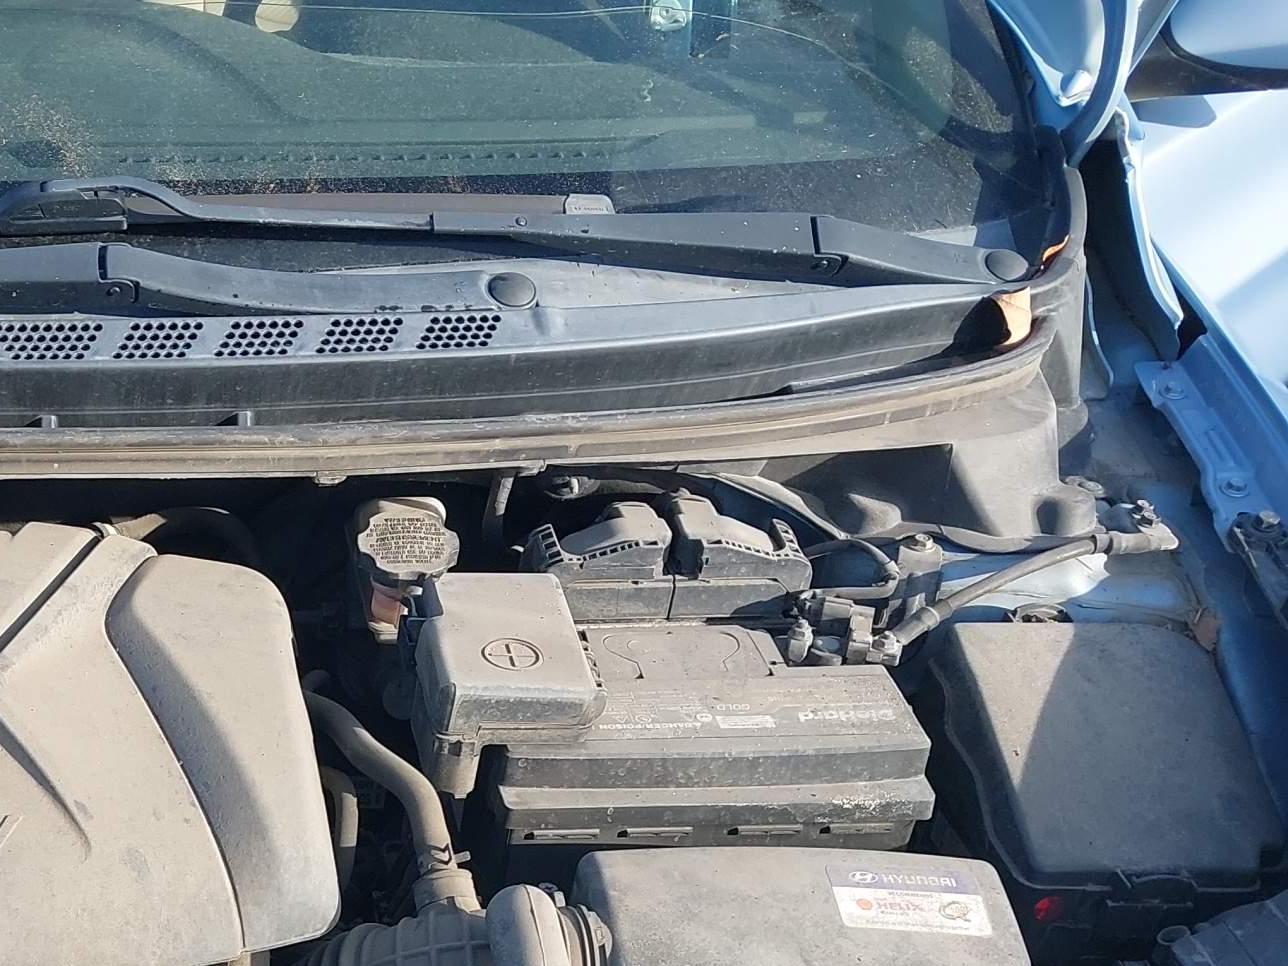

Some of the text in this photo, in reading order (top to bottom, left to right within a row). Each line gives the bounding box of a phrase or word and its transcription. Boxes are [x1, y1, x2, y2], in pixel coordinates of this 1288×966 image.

[716, 703, 751, 711] GOLD
[880, 873, 958, 888] HYUNDAI
[875, 901, 924, 912] HELIX
